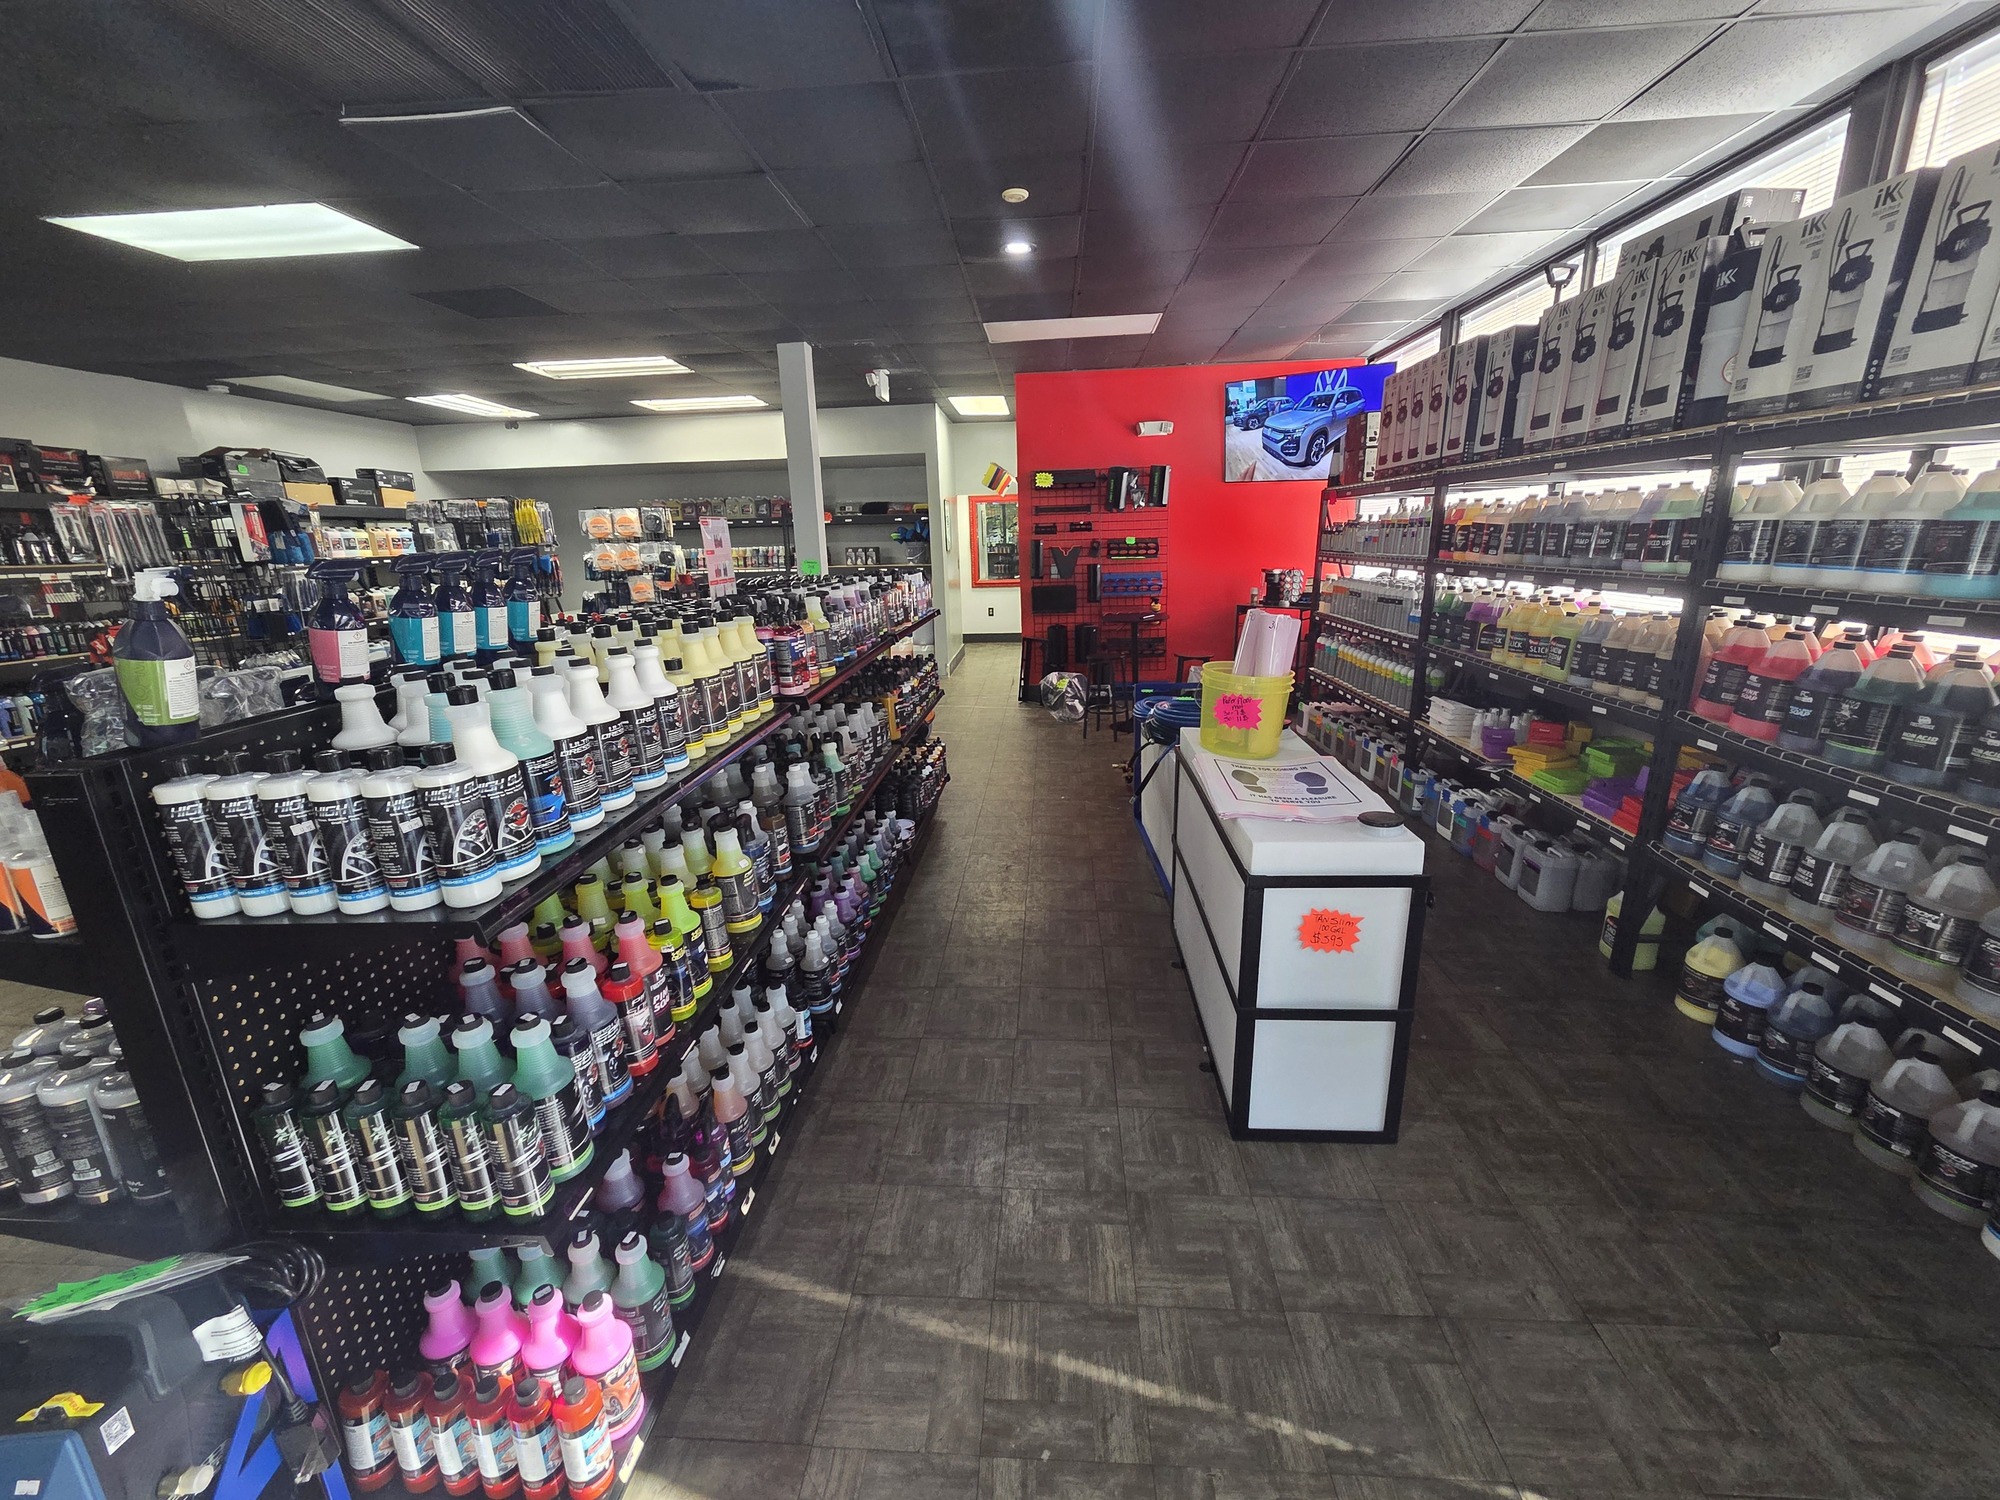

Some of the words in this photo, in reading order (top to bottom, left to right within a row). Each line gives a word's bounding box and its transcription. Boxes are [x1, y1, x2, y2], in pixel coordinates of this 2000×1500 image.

[1704, 465, 1721, 514] KOBALT
[424, 786, 460, 802] HIGH
[314, 803, 348, 818] HIGH
[1313, 913, 1330, 923] TAN
[1330, 925, 1346, 935] GAL
